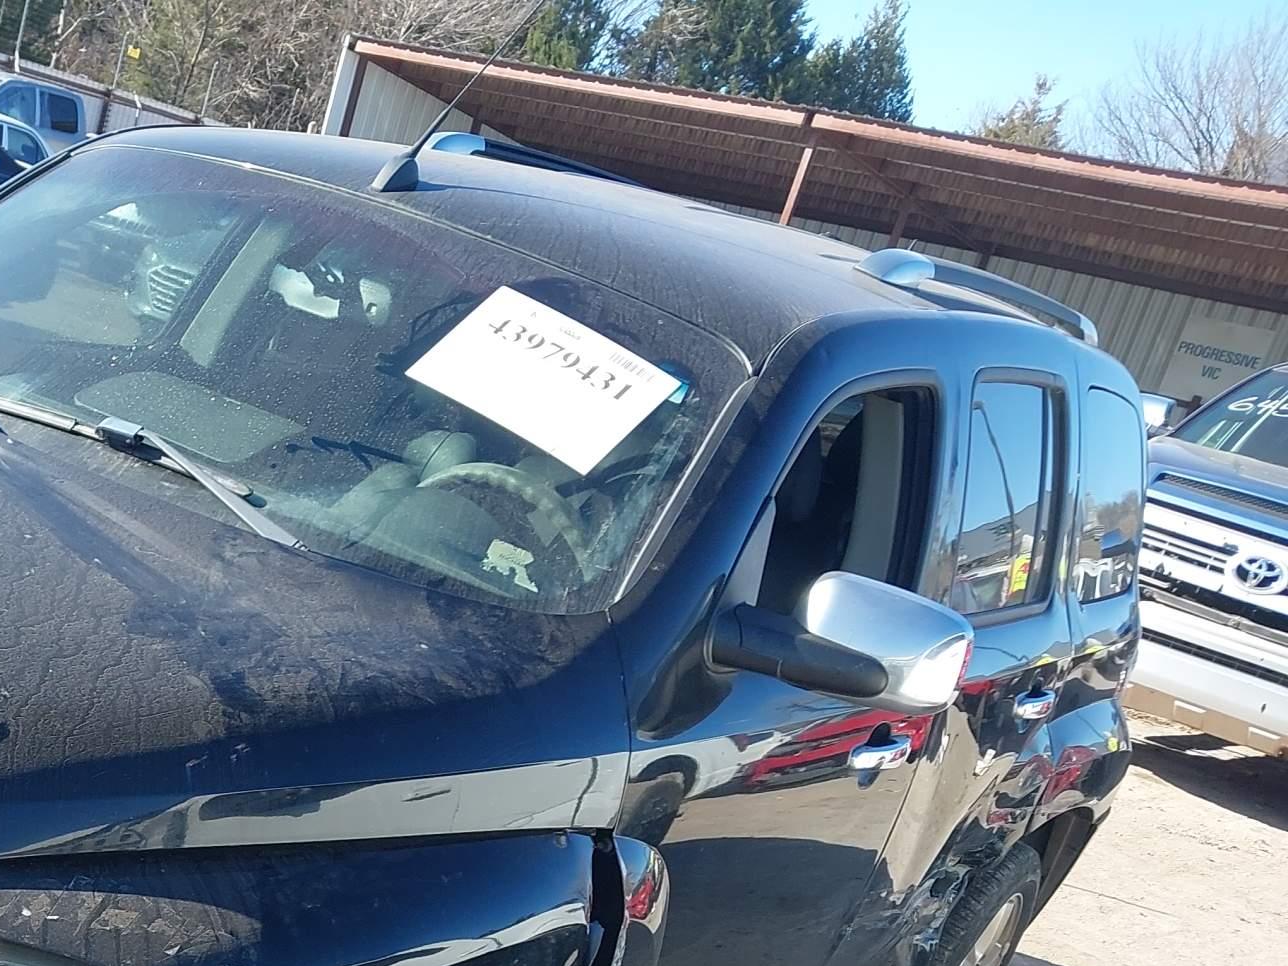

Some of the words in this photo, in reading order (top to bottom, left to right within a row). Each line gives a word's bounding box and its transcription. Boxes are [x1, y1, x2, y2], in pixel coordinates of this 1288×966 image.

[488, 319, 632, 400] 43979431
[1178, 341, 1262, 370] PROGRESSIVE
[1201, 365, 1222, 379] VIC
